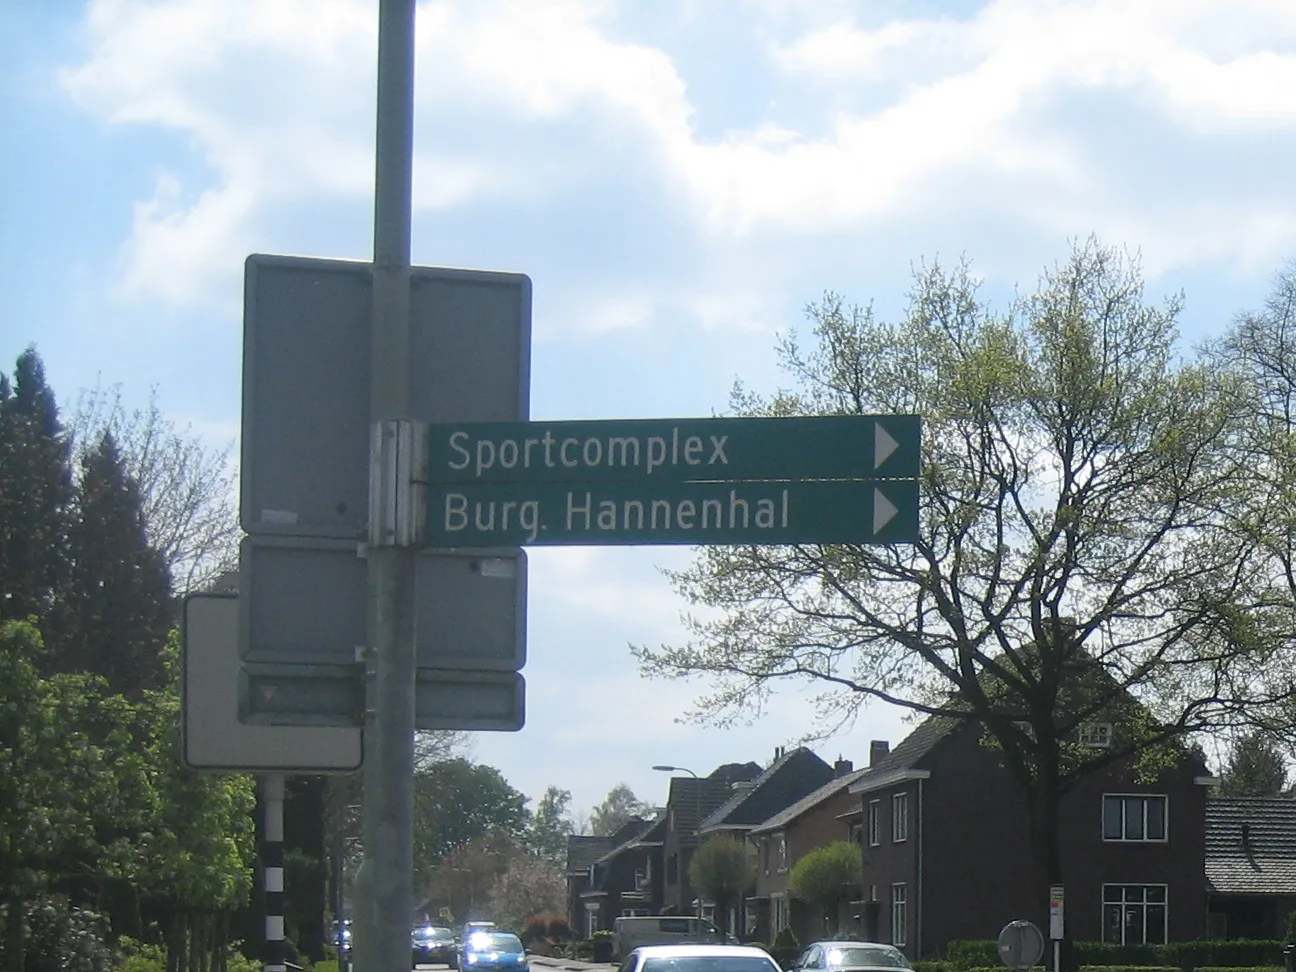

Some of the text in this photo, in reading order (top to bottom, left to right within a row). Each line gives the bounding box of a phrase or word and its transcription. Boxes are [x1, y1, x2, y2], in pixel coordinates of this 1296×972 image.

[448, 427, 729, 477] Sportcomplex
[445, 489, 789, 543] Burg. Hannenhal
